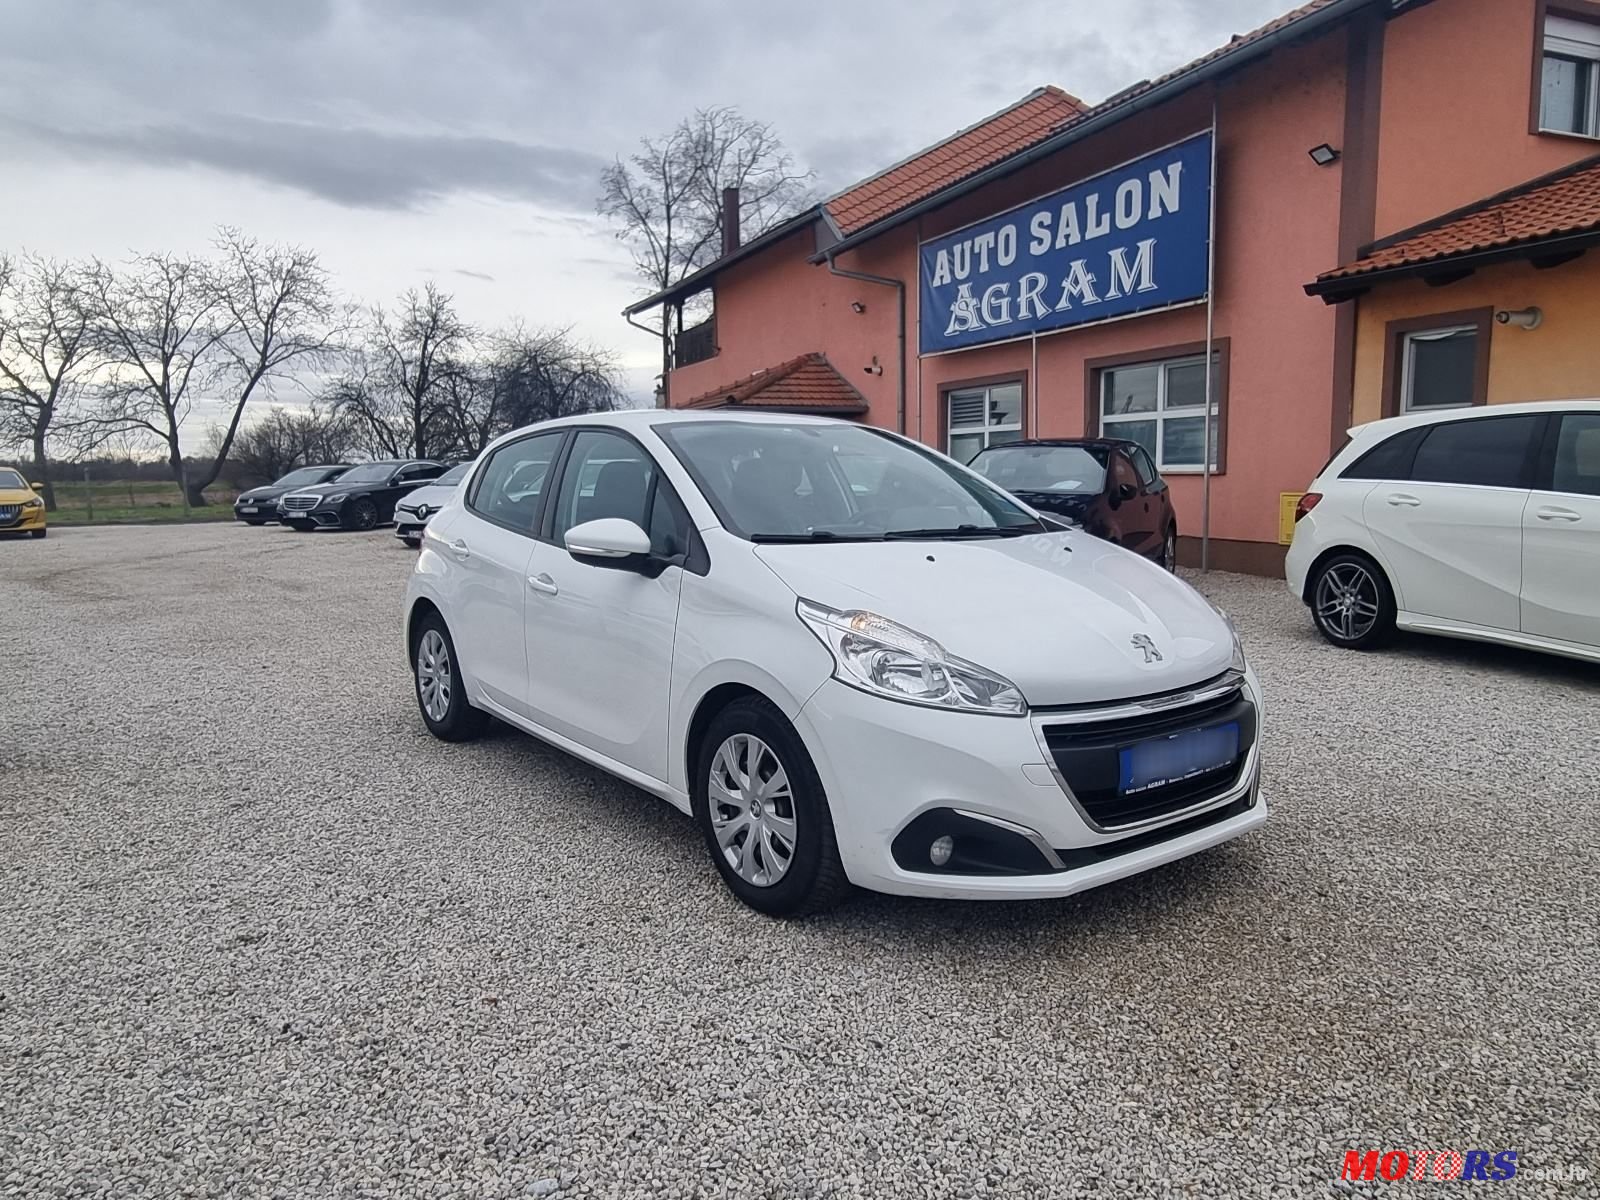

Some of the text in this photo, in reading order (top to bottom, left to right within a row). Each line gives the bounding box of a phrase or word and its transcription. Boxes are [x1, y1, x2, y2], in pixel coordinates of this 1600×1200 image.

[932, 160, 1183, 287] AUTO SALON
[943, 238, 1159, 337] AGRAM
